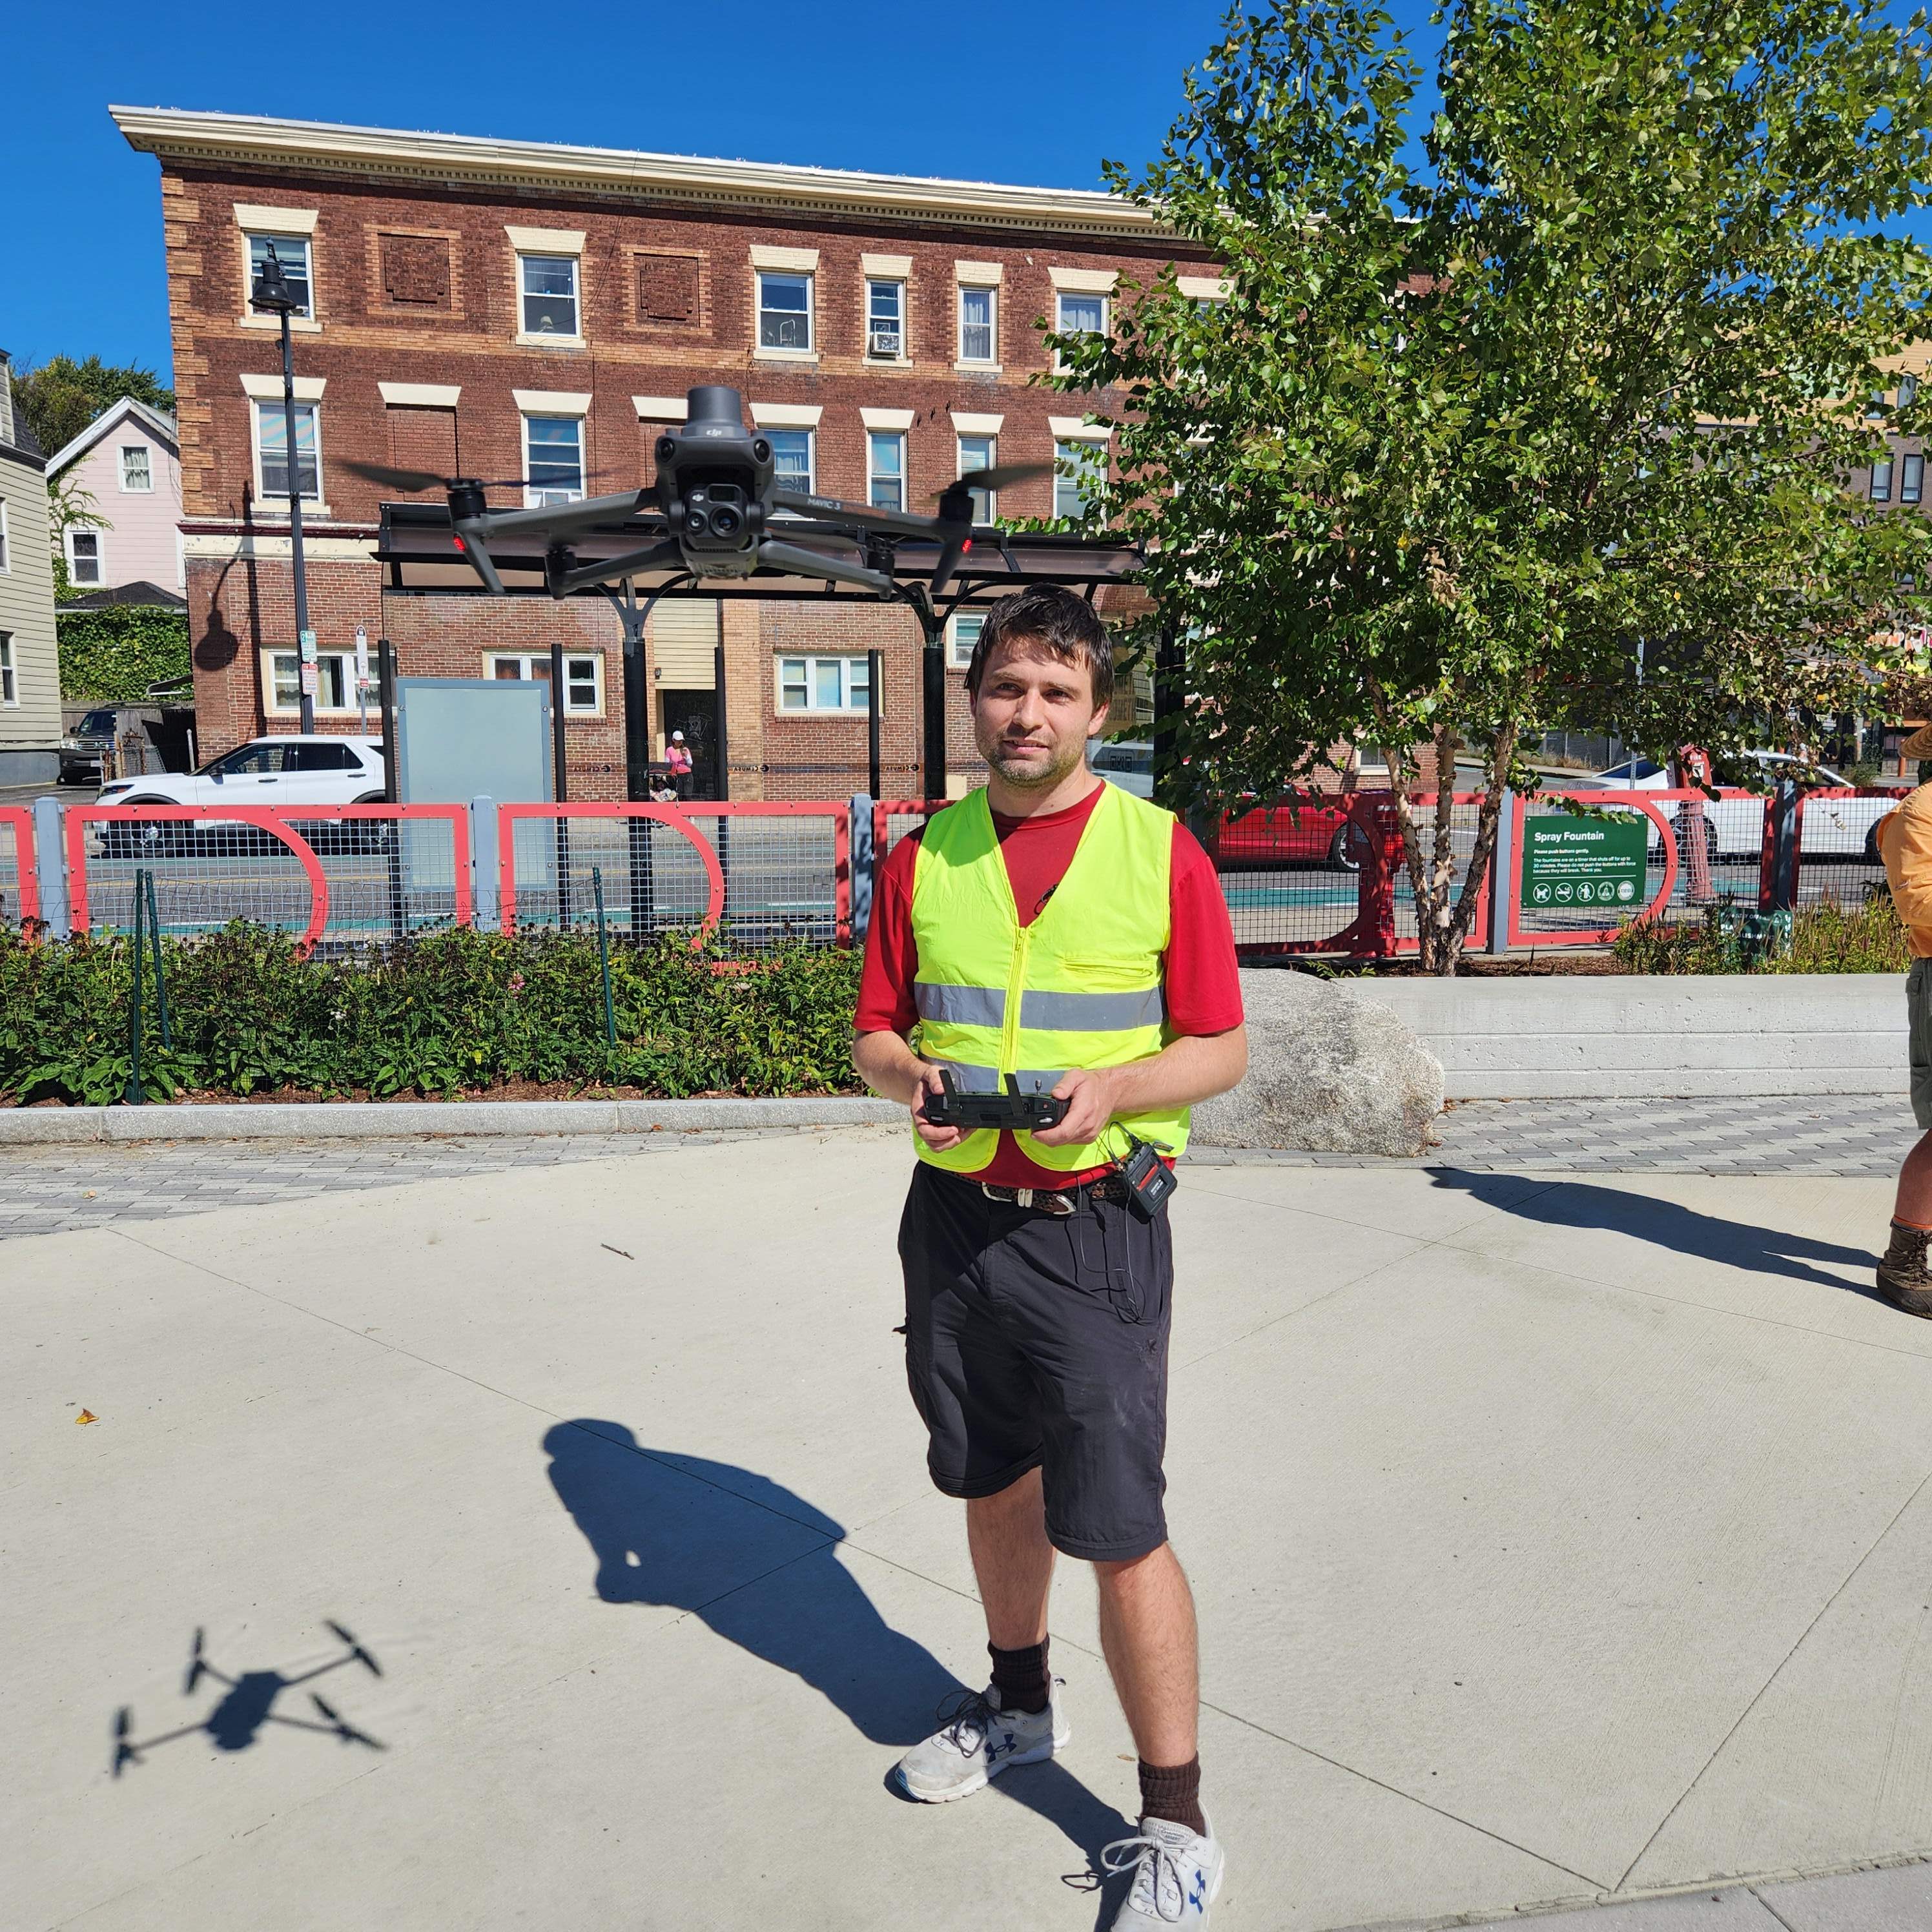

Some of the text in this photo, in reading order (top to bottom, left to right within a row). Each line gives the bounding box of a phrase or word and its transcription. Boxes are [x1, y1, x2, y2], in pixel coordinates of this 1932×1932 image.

[808, 497, 841, 511] MAVIC 3
[1534, 830, 1605, 843] Spray Fountain
